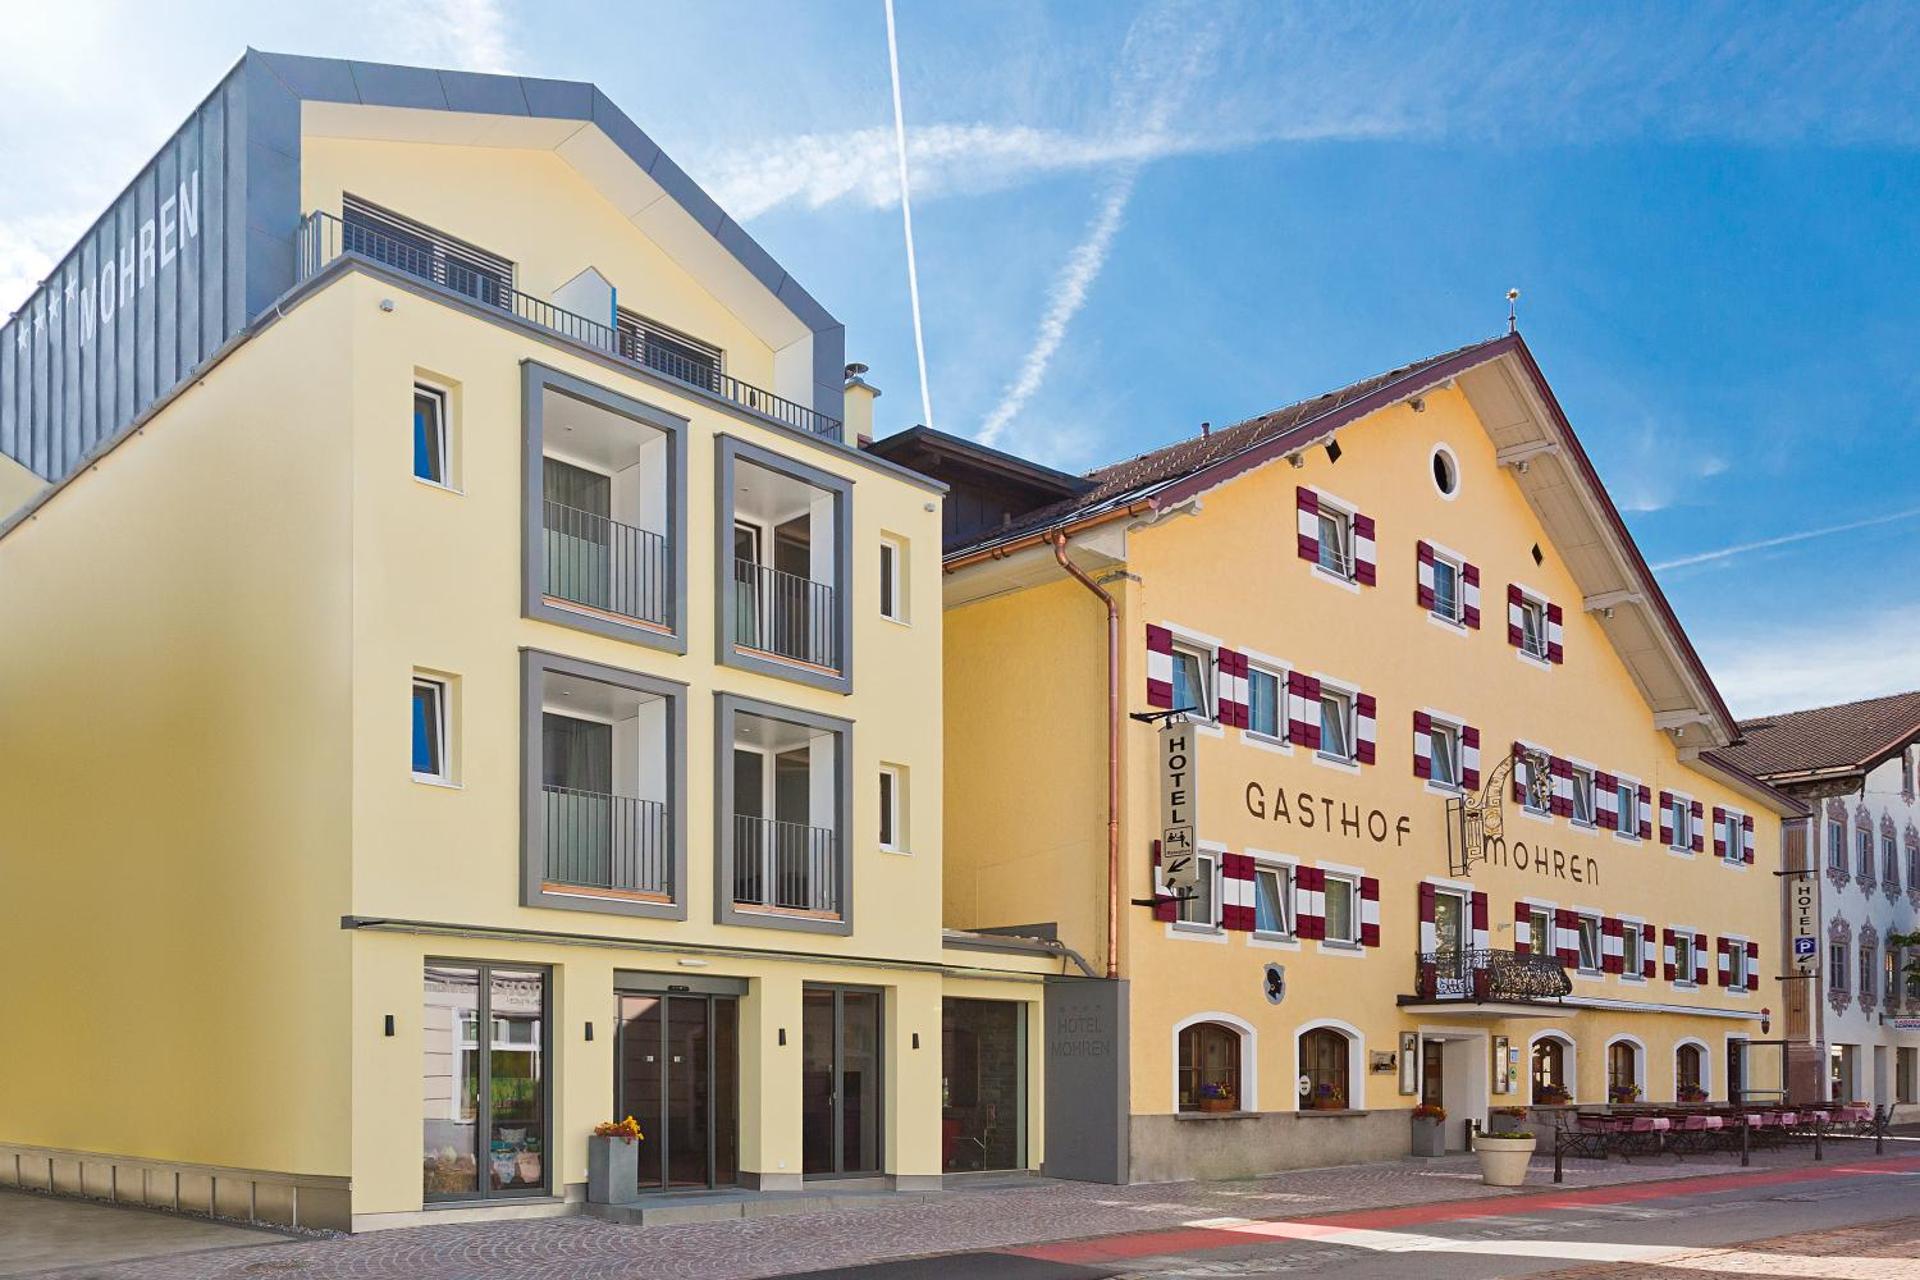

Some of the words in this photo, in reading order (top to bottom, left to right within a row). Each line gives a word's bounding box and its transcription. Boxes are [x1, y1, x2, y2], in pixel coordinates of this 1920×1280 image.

[1168, 736, 1187, 824] HOTEL
[1246, 781, 1410, 847] GASTHOF
[1798, 887, 1811, 936] HOTEL
[1800, 943, 1811, 953] P
[1058, 1017, 1104, 1034] HOTEL
[1050, 1040, 1110, 1057] MOHREN
